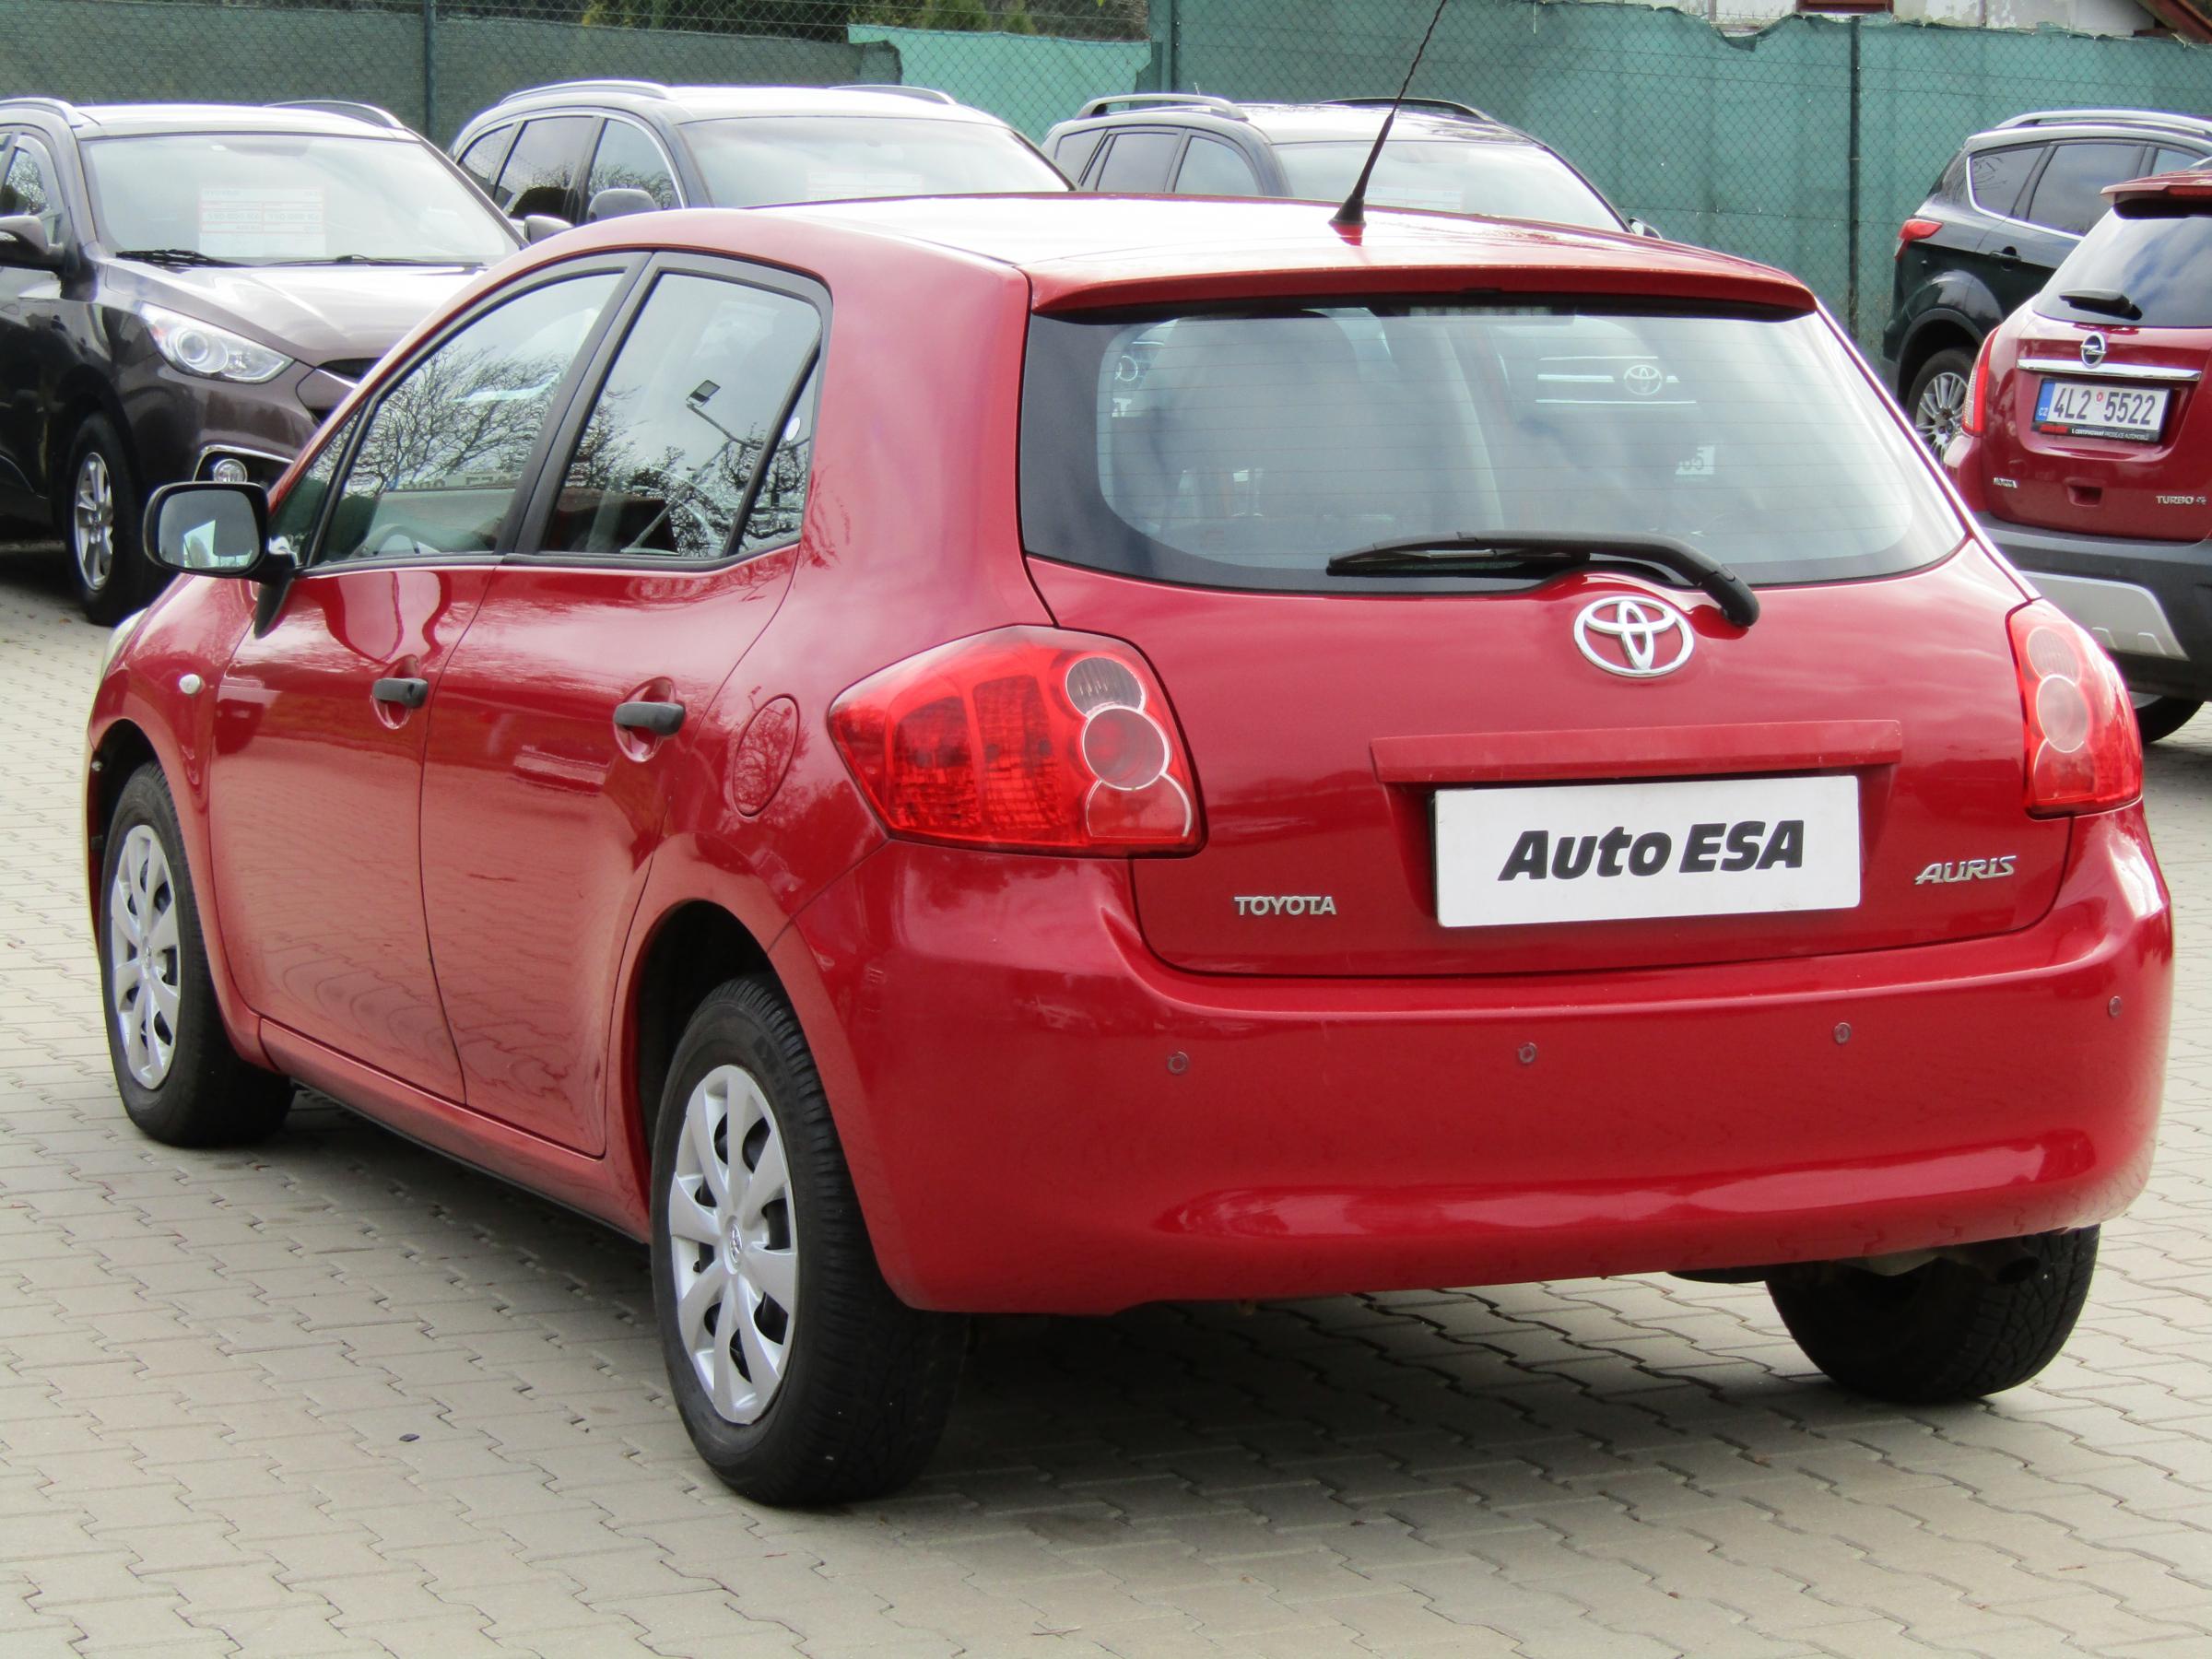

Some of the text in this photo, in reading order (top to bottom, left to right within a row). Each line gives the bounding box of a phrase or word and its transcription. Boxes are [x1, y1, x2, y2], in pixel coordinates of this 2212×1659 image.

[2039, 406, 2049, 417] CZ
[2053, 387, 2156, 426] 4L2 5522
[2155, 495, 2194, 505] TURBO
[1498, 820, 1805, 881] Auto ESA
[1914, 855, 2017, 885] AURIS
[1234, 896, 1337, 916] TOYOTA
